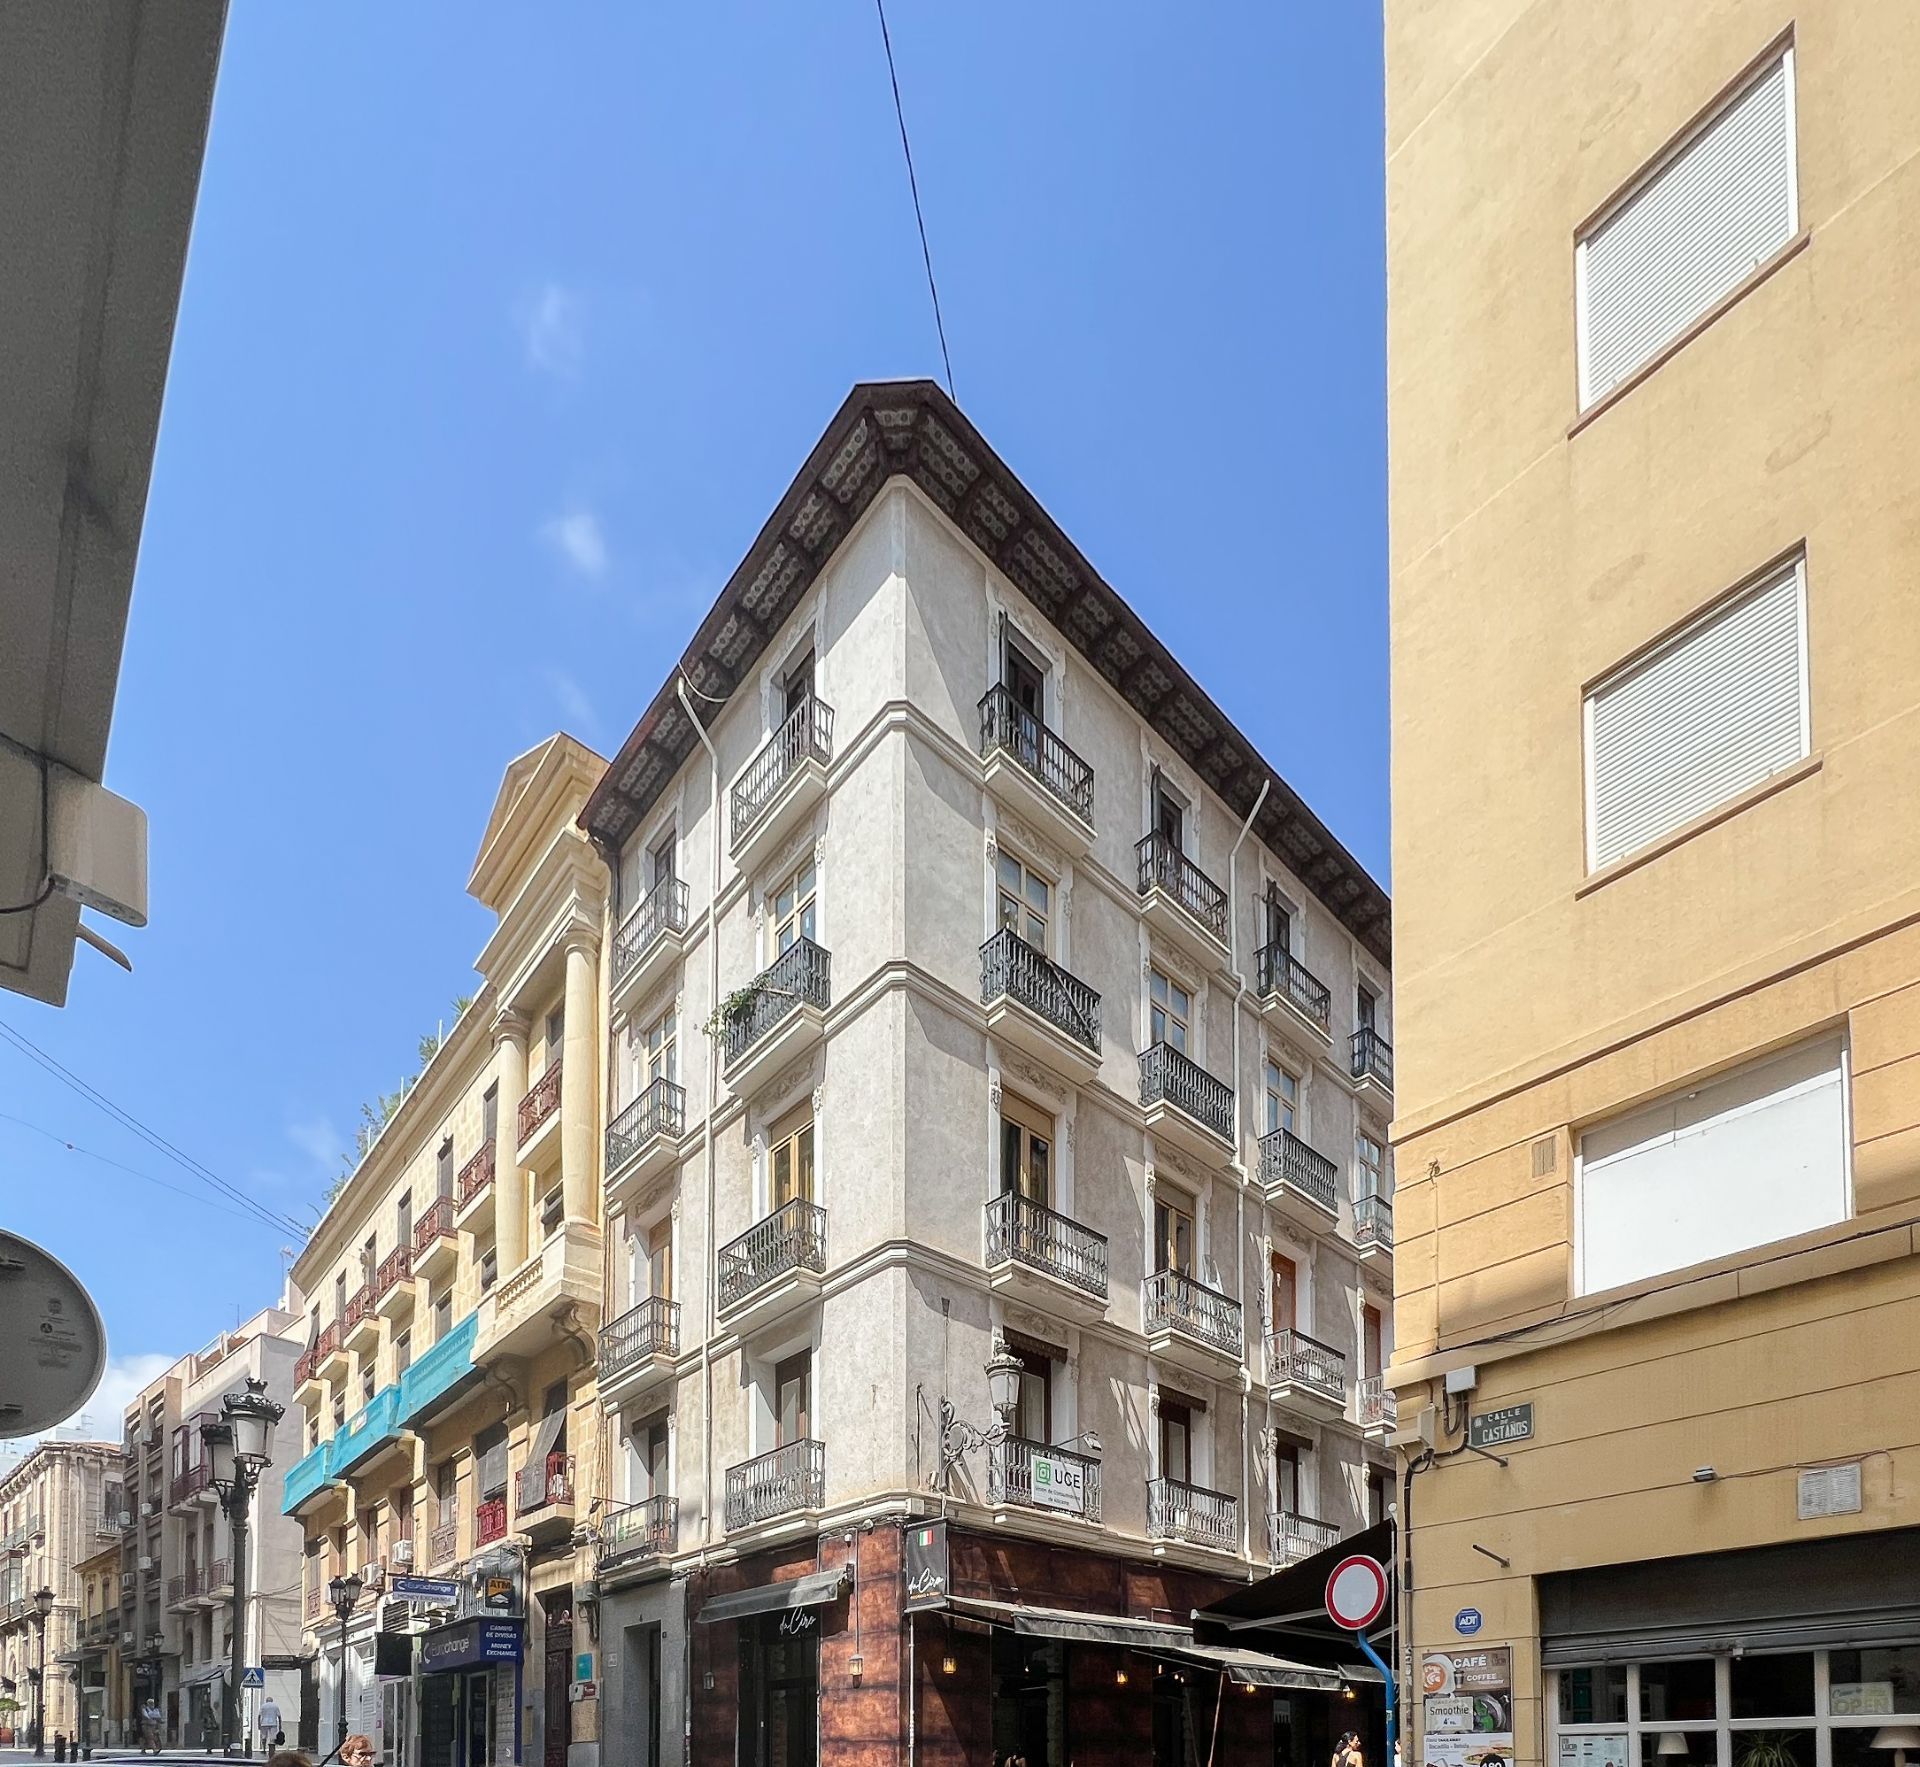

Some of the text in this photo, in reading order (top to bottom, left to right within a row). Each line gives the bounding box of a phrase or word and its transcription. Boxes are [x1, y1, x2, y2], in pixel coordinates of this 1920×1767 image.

[1487, 1408, 1521, 1422] CALLE
[1482, 1420, 1528, 1443] CASTAÑOS
[1054, 1468, 1080, 1489] UCE
[407, 1581, 452, 1593] Eurochange
[490, 1579, 512, 1590] ATM
[918, 1567, 945, 1594] Ciro
[790, 1606, 817, 1635] Ciro
[1459, 1616, 1478, 1626] ADT
[490, 1624, 514, 1632] CAMBIO
[431, 1635, 470, 1657] Eurochange
[1453, 1655, 1487, 1669] CAFÉ
[1466, 1673, 1498, 1682] COFFEE
[1429, 1705, 1469, 1716] Smoothie
[1833, 1697, 1890, 1714] OPEN
